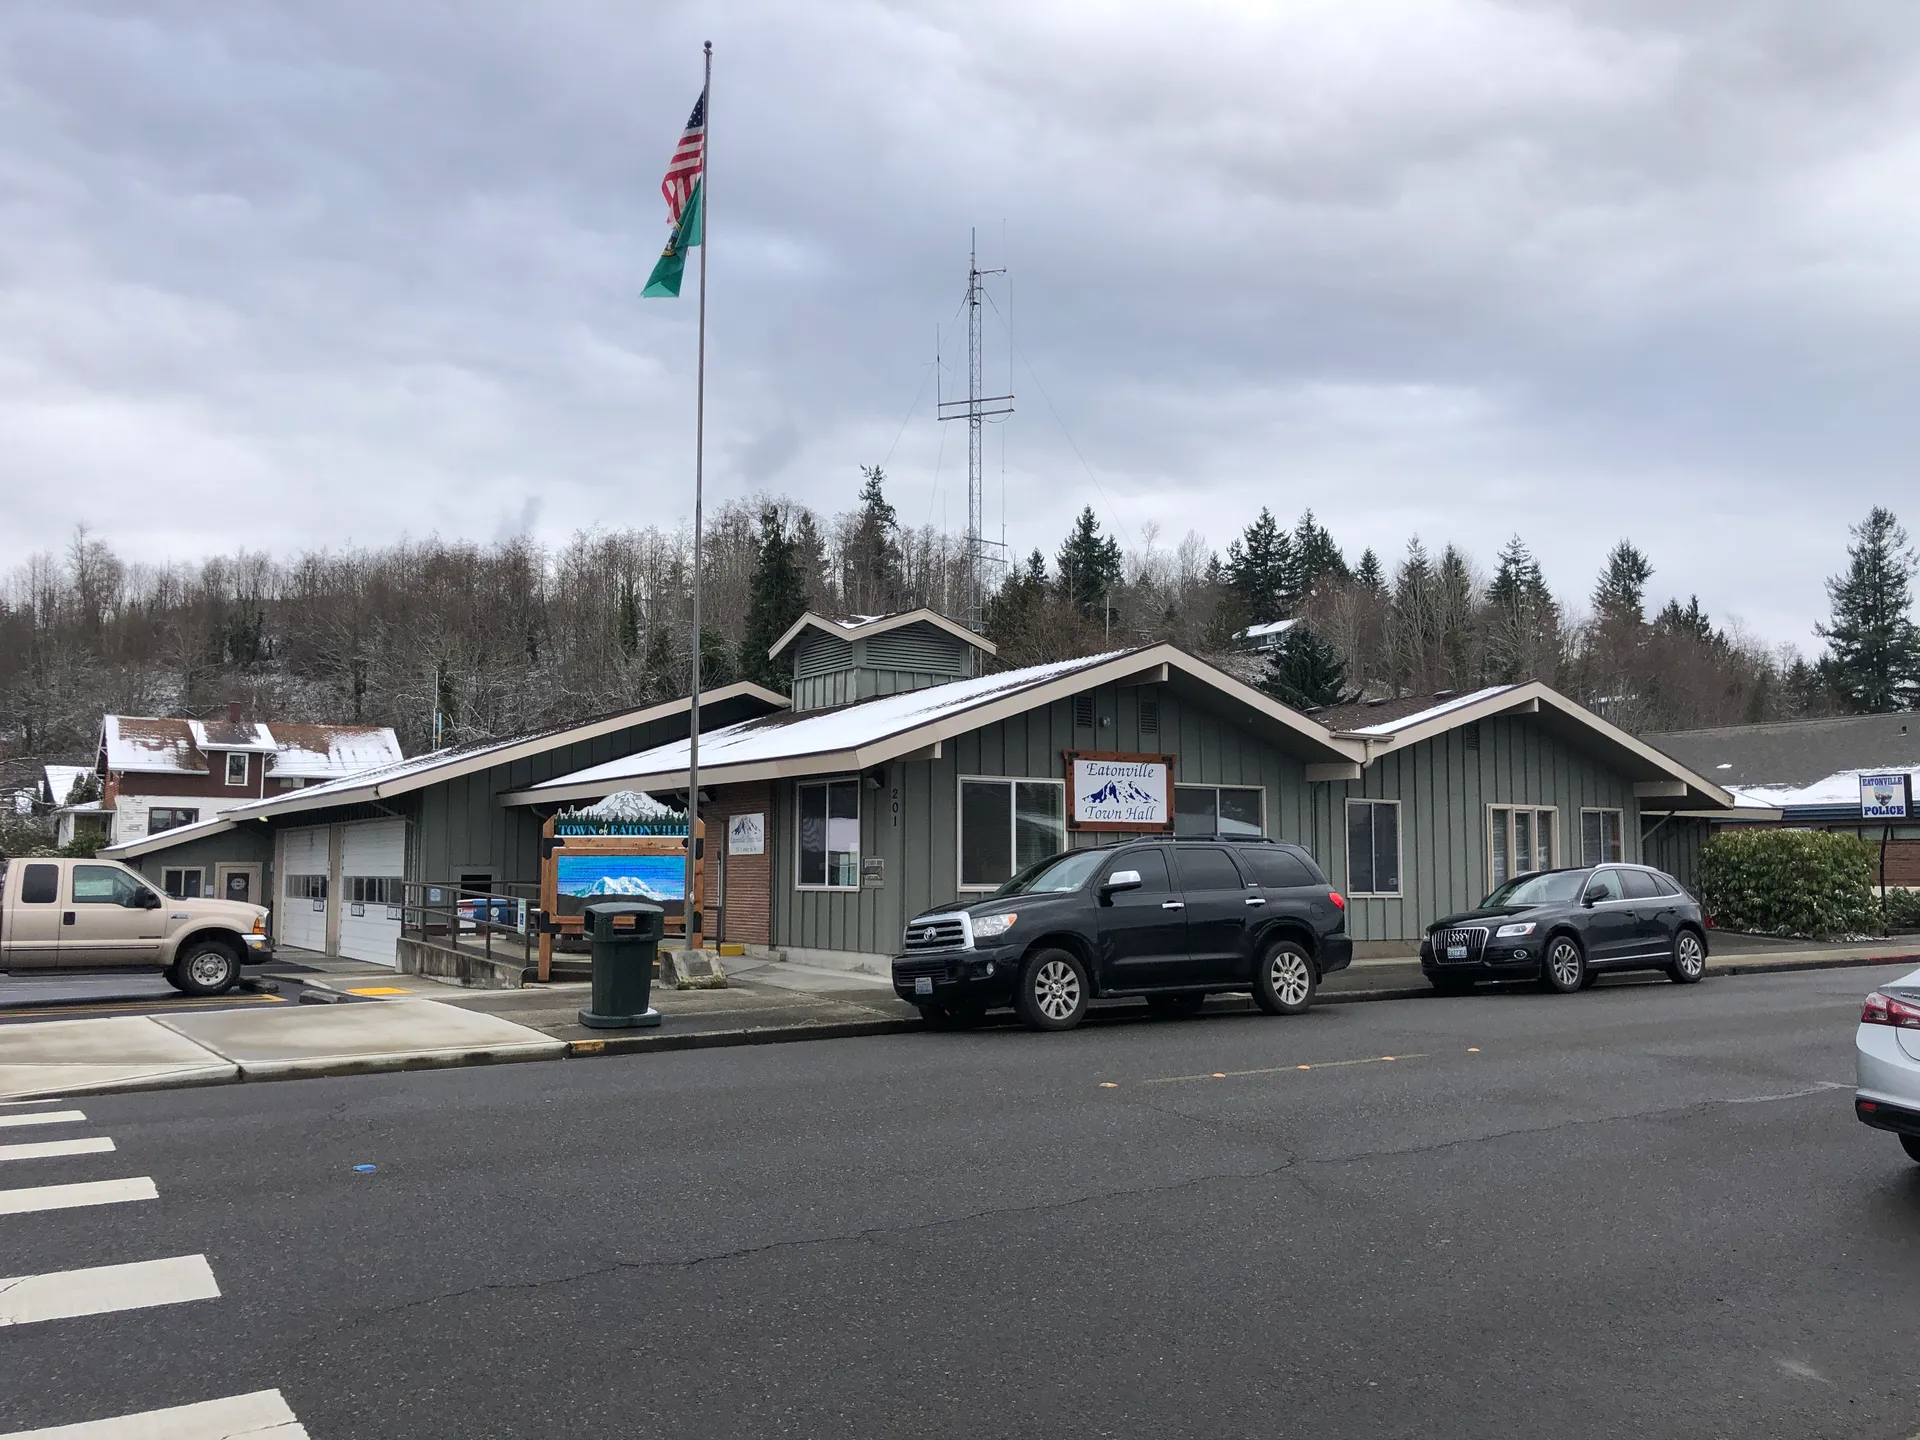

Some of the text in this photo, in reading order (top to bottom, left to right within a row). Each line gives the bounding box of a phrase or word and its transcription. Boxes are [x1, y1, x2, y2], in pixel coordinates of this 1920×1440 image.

[1086, 762, 1154, 778] Eatonville
[1862, 777, 1902, 786] EATONVILLE
[1085, 805, 1157, 821] Town Hall
[1864, 806, 1904, 816] POLICE
[558, 824, 597, 836] TOWN
[598, 823, 609, 836] of
